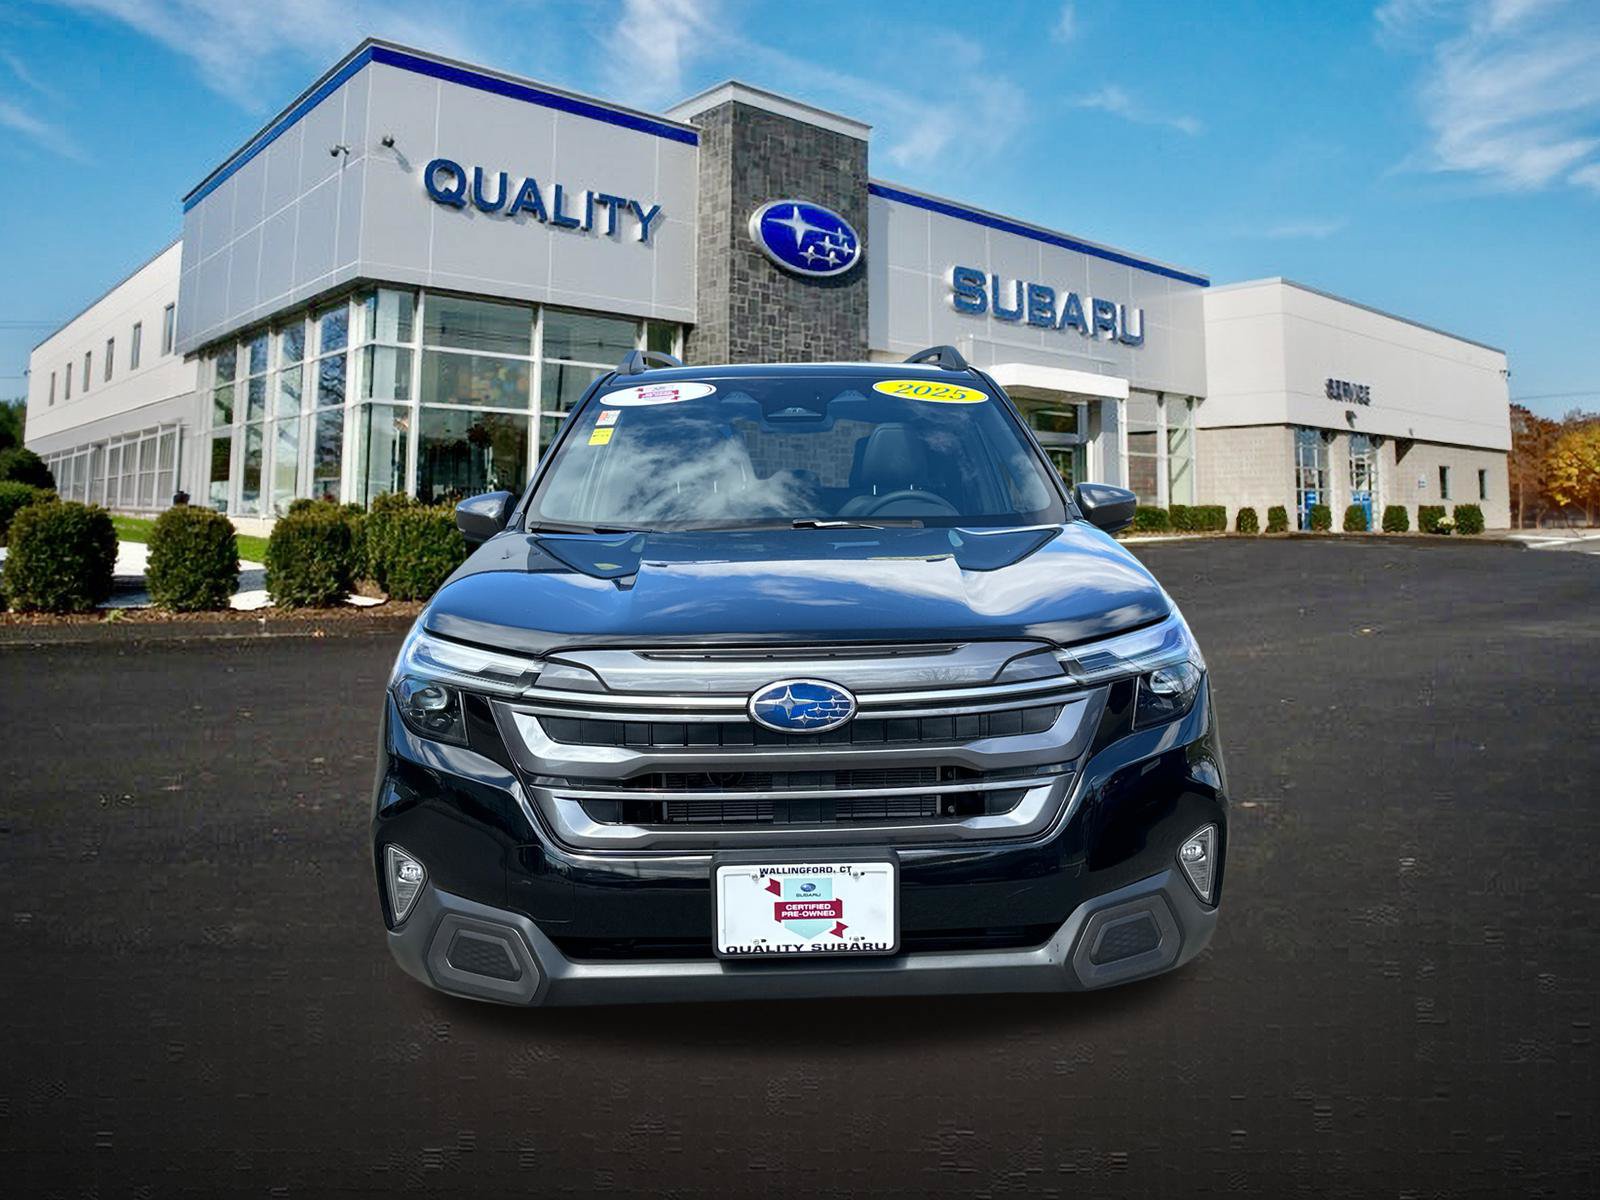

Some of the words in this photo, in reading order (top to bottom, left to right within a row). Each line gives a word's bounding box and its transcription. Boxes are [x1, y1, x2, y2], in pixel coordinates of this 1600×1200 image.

[423, 158, 662, 243] QUALITY
[950, 265, 1145, 347] SUBARU
[894, 383, 968, 400] 2025
[839, 865, 852, 873] CT
[785, 903, 831, 911] CERTIFIED
[726, 944, 804, 954] QUALITY
[811, 942, 887, 951] SUBARU
